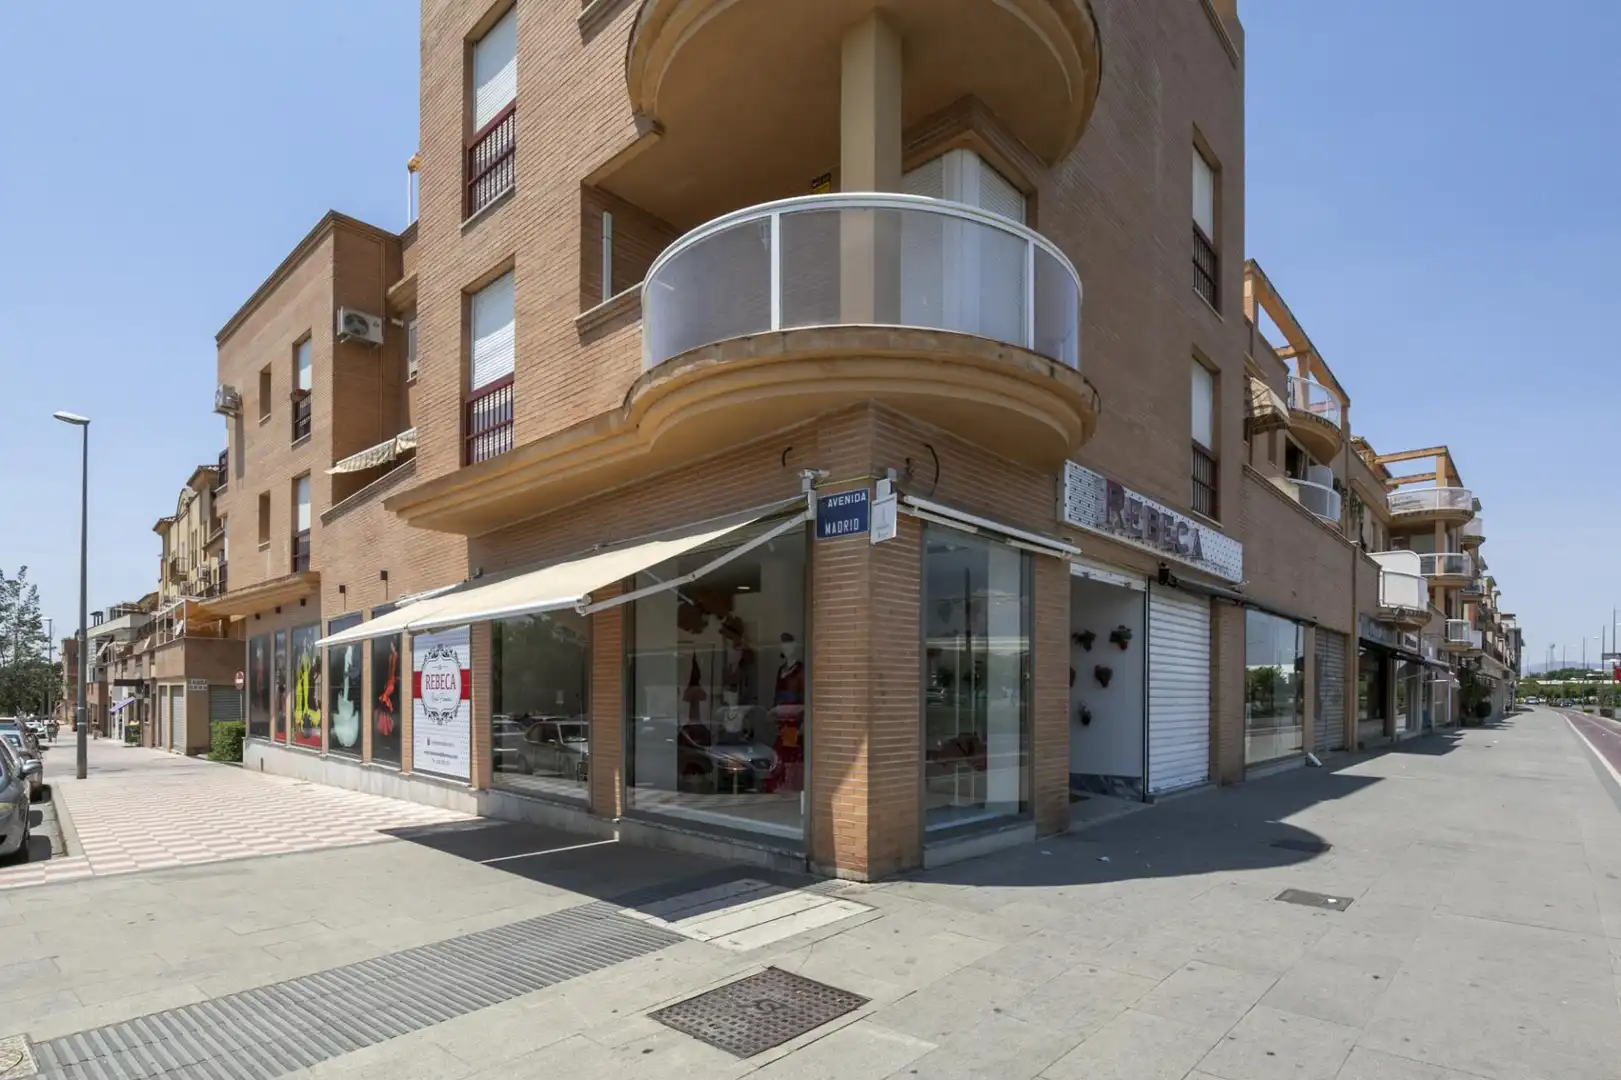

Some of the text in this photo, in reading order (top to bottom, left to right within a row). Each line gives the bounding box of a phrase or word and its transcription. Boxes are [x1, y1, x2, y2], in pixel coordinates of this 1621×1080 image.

[827, 491, 867, 508] AVENIDA
[824, 518, 859, 536] MADRID
[1104, 479, 1204, 560] REBECA
[425, 673, 456, 690] REBECA
